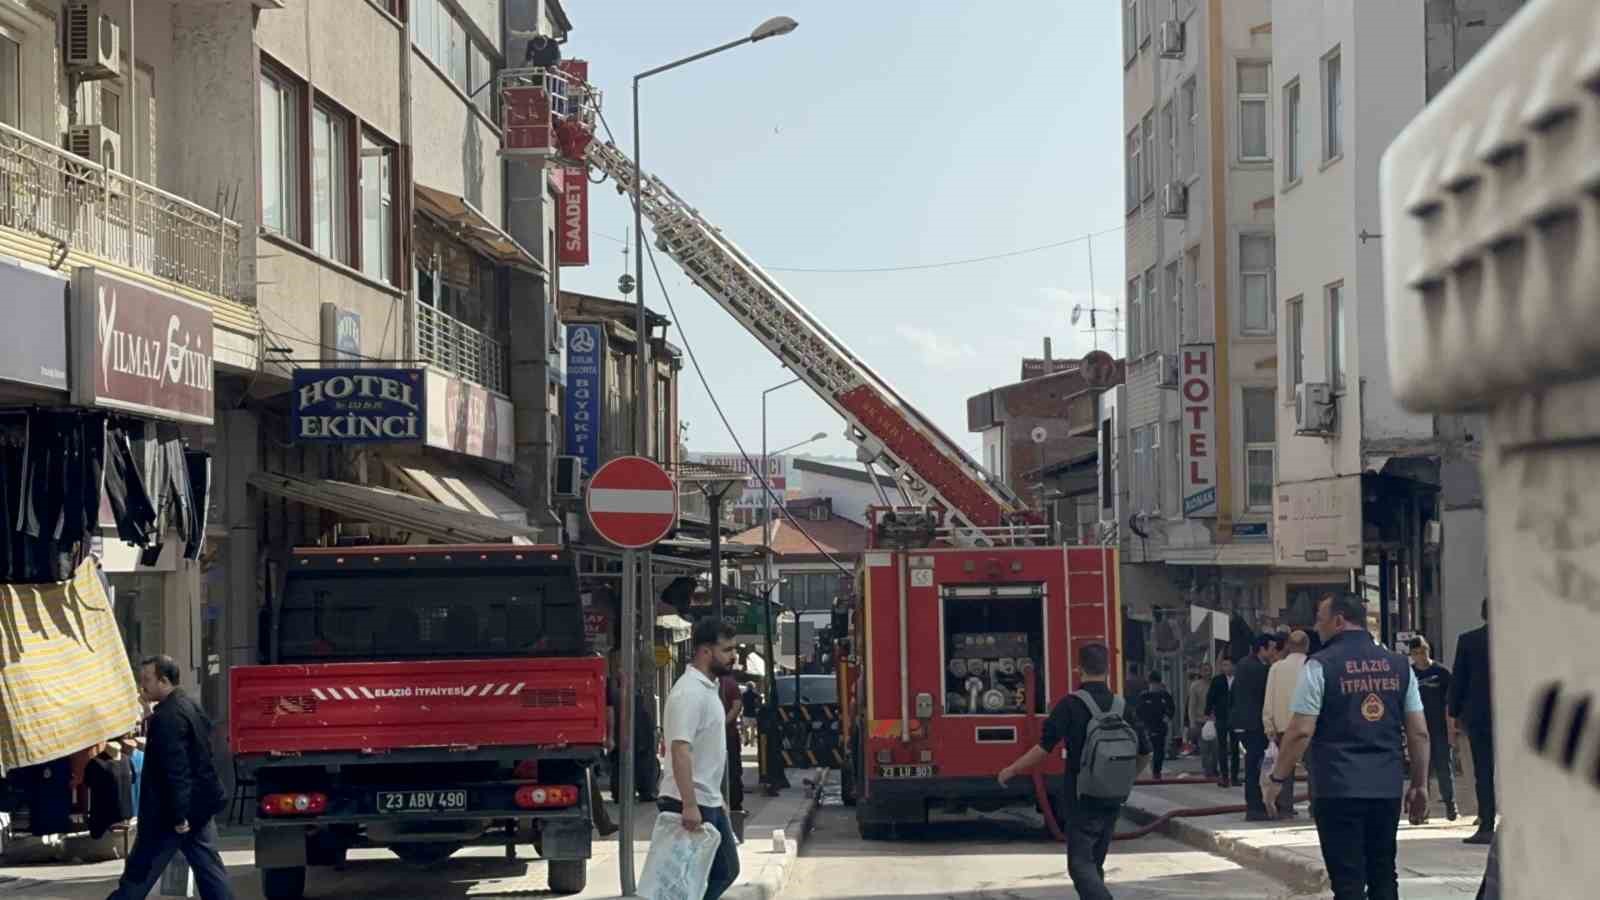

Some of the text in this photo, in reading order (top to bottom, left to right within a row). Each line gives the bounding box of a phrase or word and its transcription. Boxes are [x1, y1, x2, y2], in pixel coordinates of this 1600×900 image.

[565, 182, 582, 252] SAADET
[98, 285, 161, 393] YILMAZ
[298, 375, 419, 411] HOTEL
[299, 411, 419, 438] EKİNCİ
[1183, 351, 1211, 485] HOTEL
[1345, 657, 1391, 673] ELAZIĞ
[374, 685, 464, 697] ELAZIĞ İTFAİYESİ
[1339, 673, 1401, 695] İTFAİYESİ
[386, 791, 464, 808] 23 ABV 490
